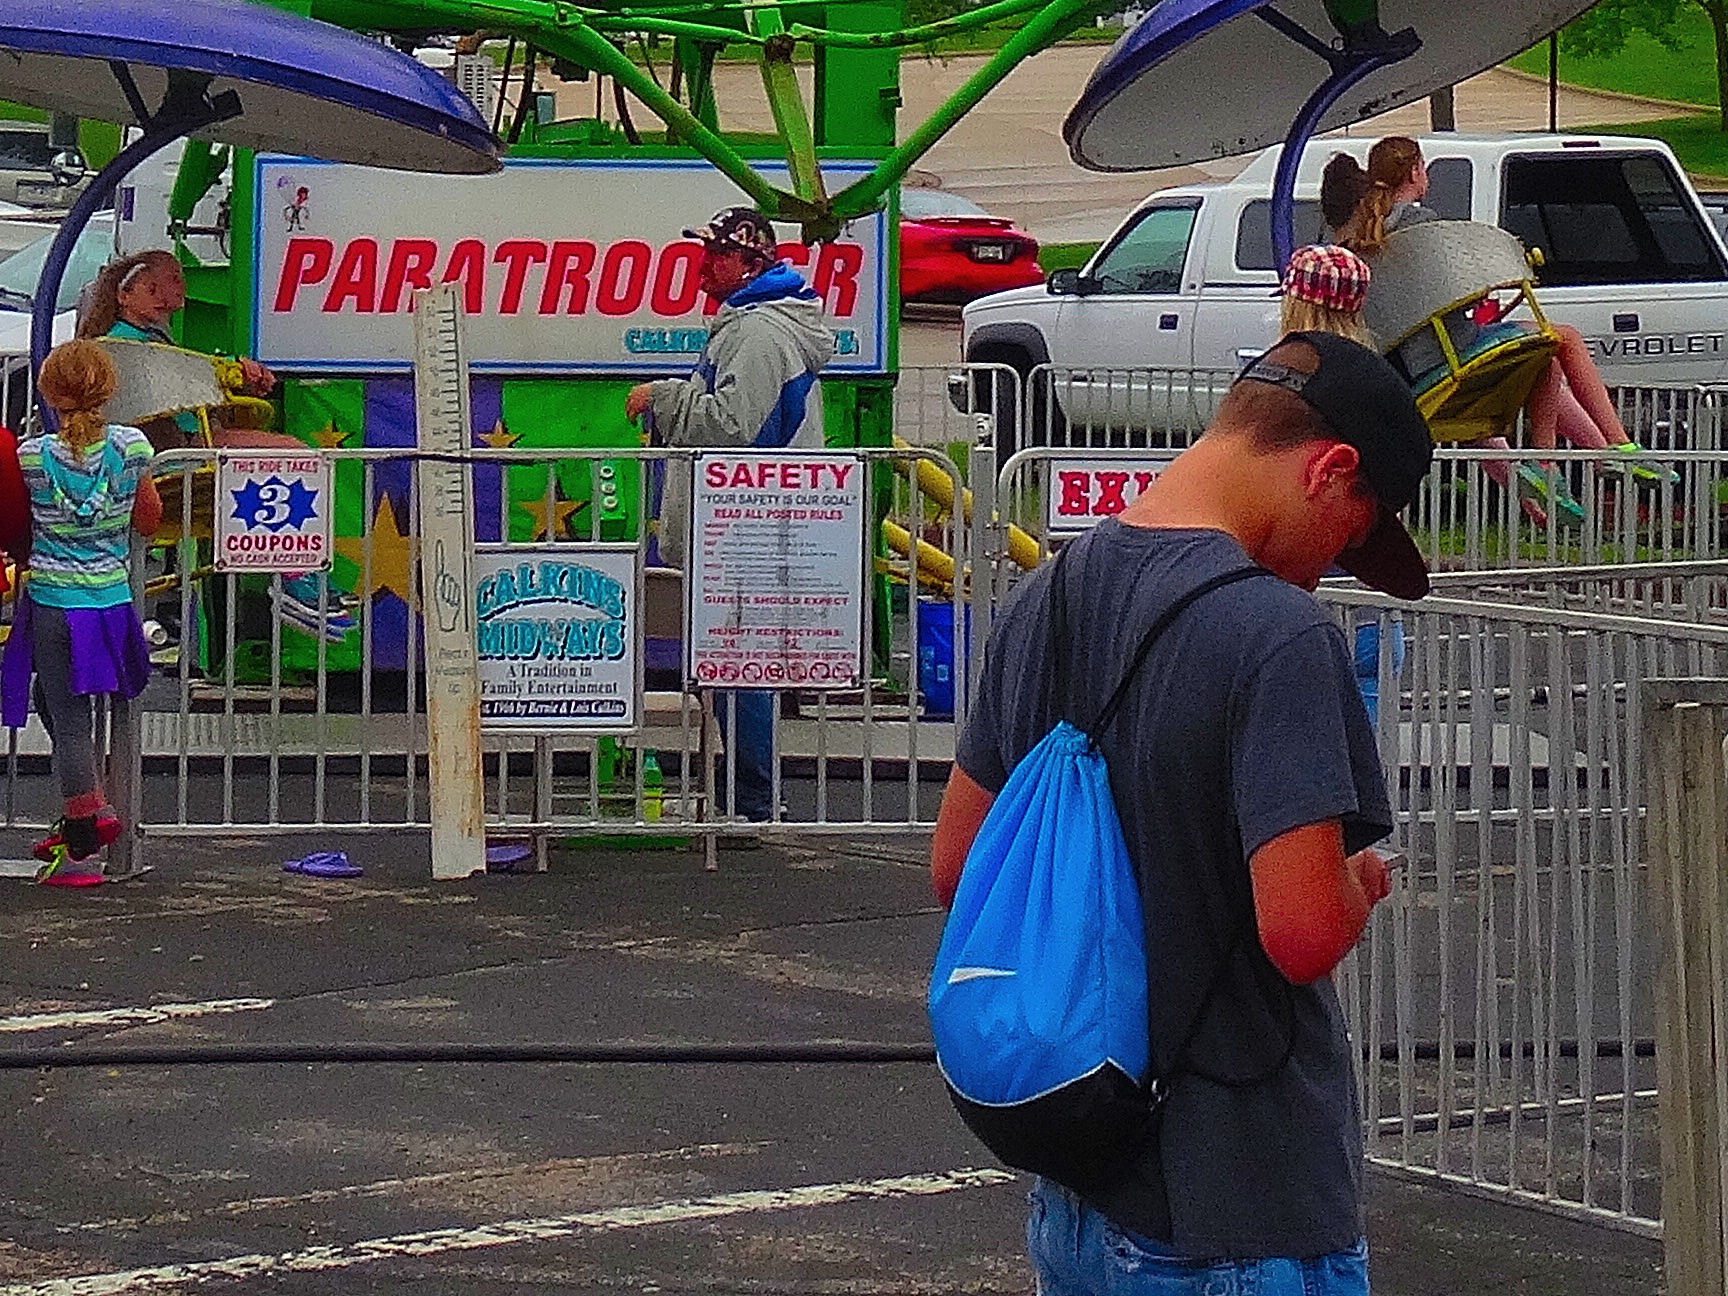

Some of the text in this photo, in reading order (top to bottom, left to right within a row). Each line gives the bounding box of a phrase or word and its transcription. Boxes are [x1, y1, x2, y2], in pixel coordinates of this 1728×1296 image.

[273, 238, 864, 318] PARATROOR
[1583, 334, 1724, 358] EVROLET
[233, 461, 318, 473] THIS RIDE TAKES
[705, 462, 853, 489] SAFETY
[739, 494, 779, 506] SAFETY
[782, 495, 793, 505] IS
[797, 495, 819, 505] OUR
[1058, 471, 1162, 516] EX
[254, 484, 290, 524] 3
[715, 509, 843, 520] READ ALL POSTED RULES
[227, 535, 322, 551] COUPONS
[476, 561, 626, 621] CALKINS
[754, 597, 800, 605] SHOULD
[804, 597, 848, 605] EXPECT
[477, 619, 626, 661] MIDWAYS
[708, 628, 751, 636] HEIGHT
[506, 663, 592, 678] A Tradition in
[481, 679, 618, 698] Family Entertainment
